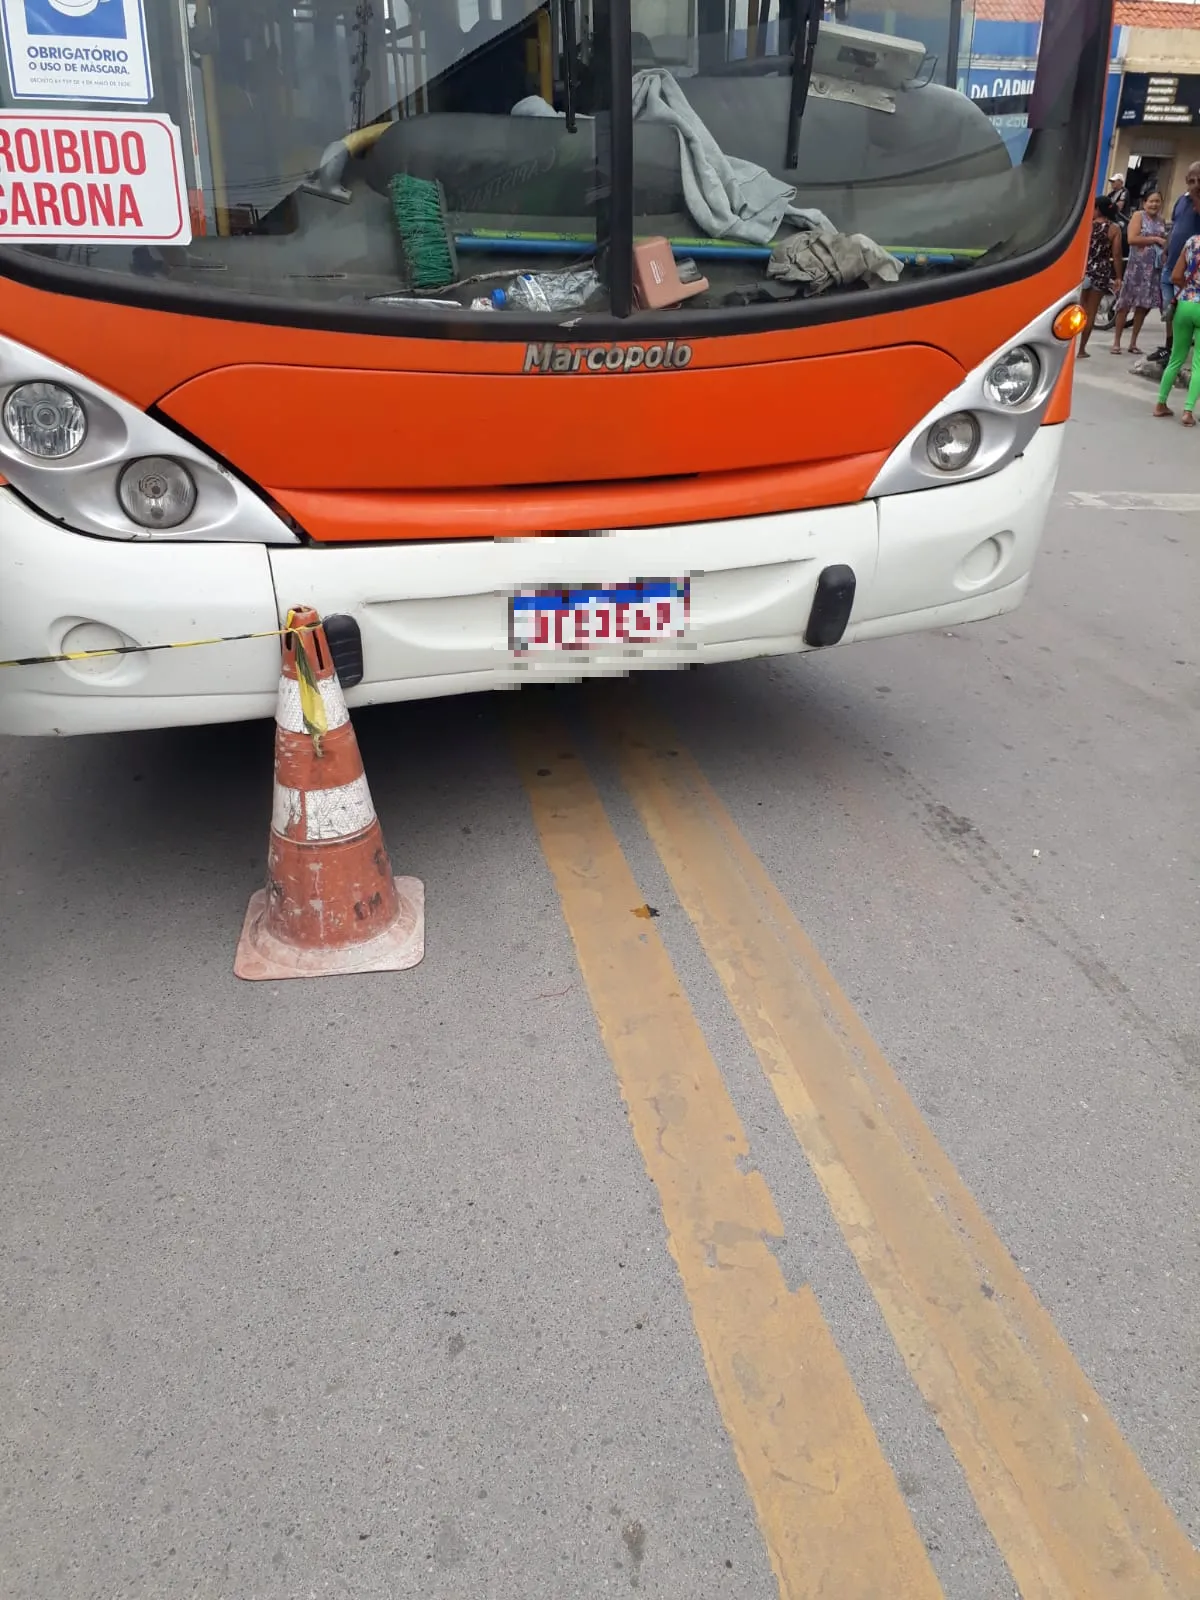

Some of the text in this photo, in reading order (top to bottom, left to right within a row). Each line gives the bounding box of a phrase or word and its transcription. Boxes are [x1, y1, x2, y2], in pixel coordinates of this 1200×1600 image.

[27, 44, 128, 62] OBRIGATÓRIO
[28, 61, 37, 71] O
[40, 62, 61, 71] USO
[64, 63, 78, 72] DE
[522, 341, 693, 373] Marcopolo
